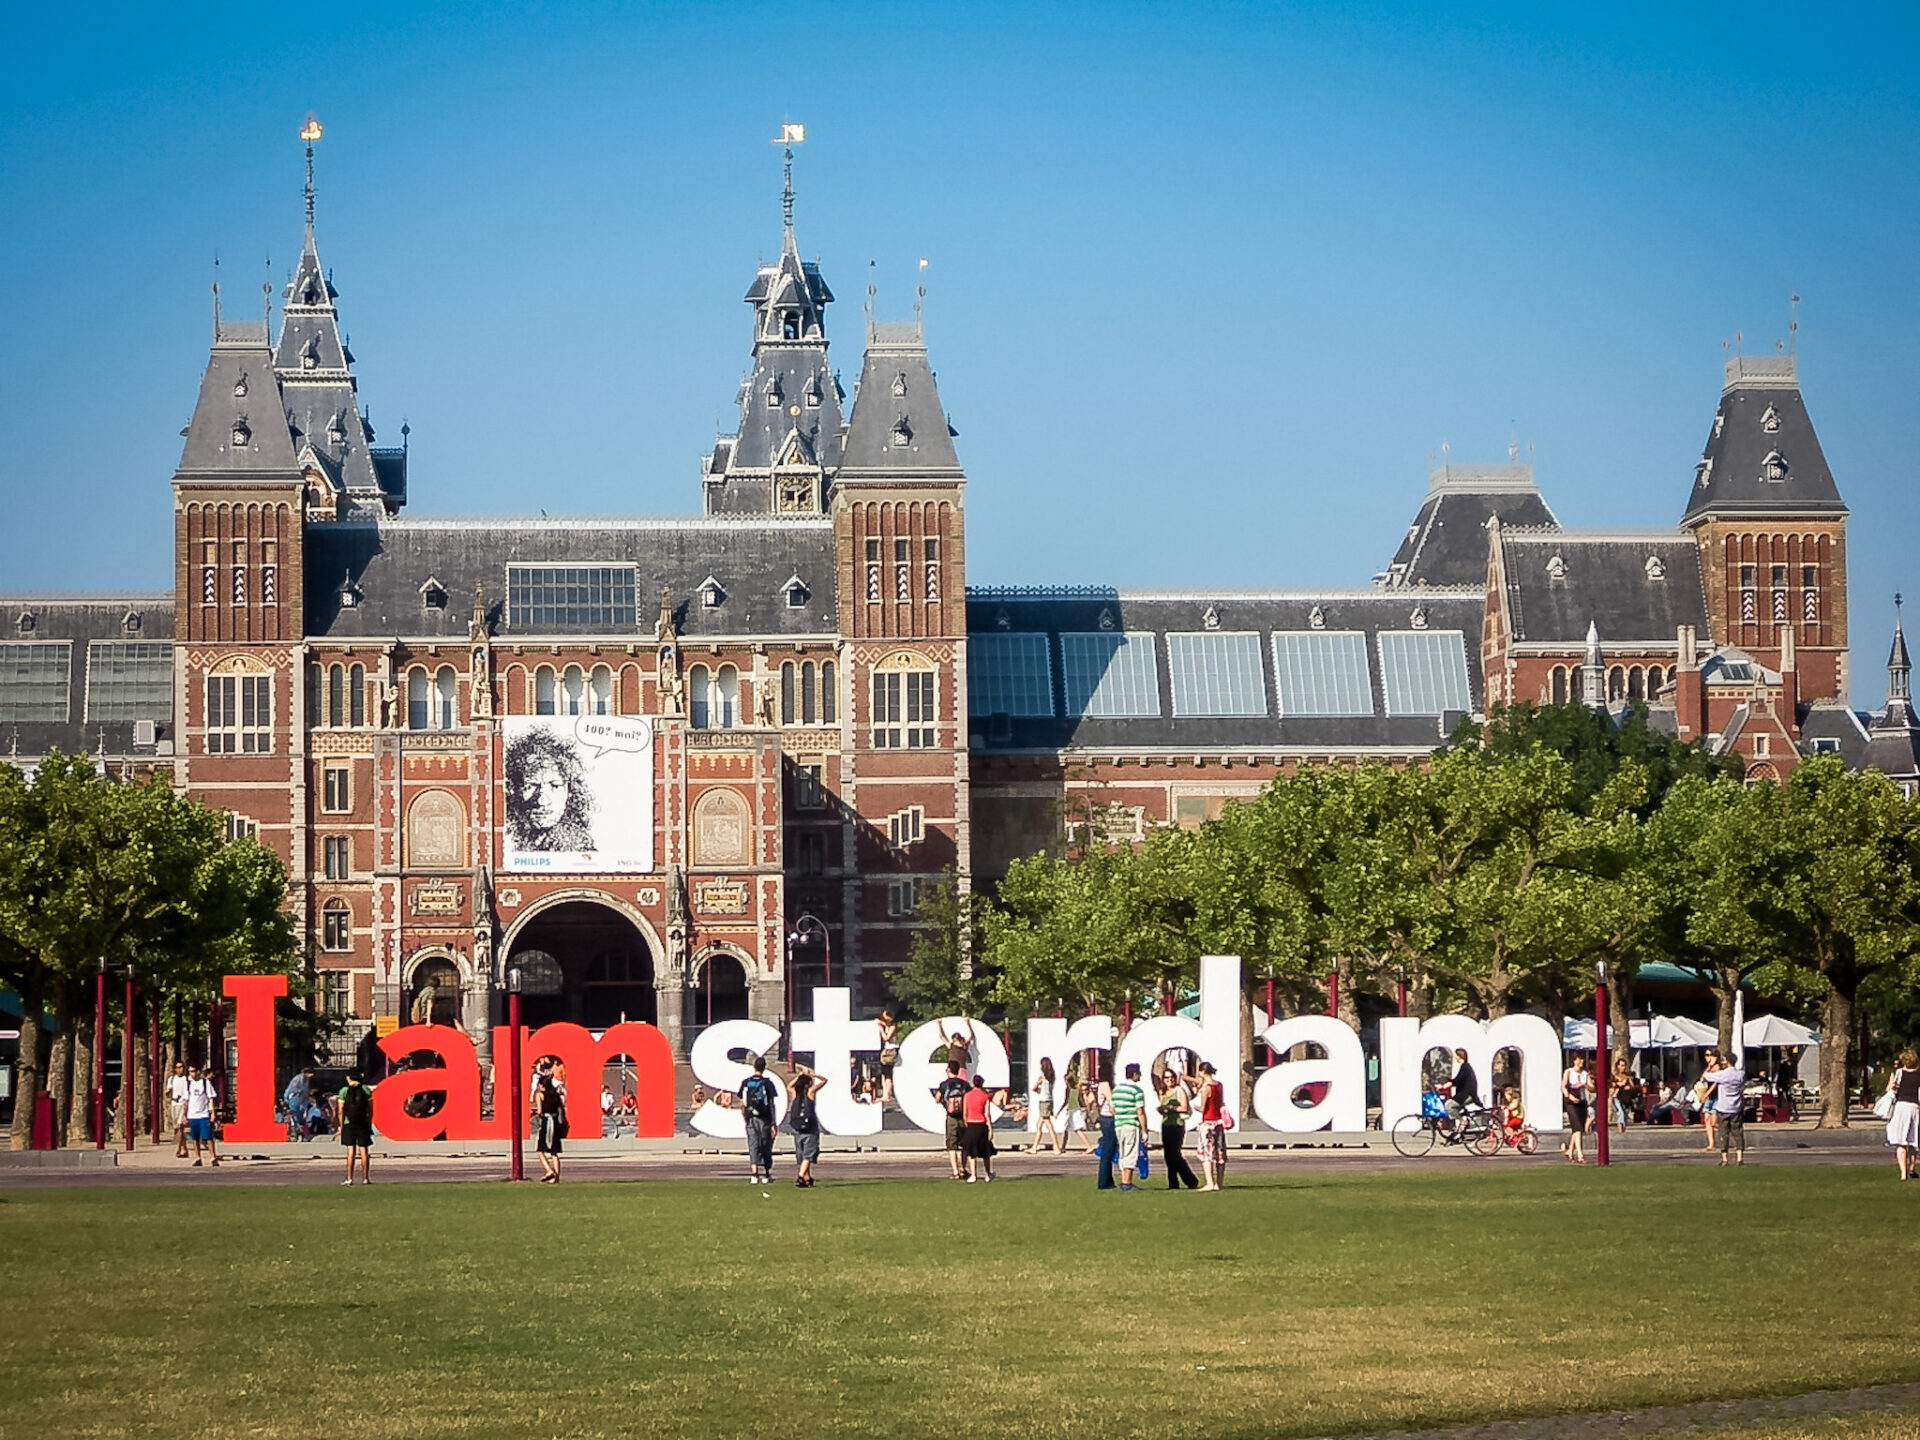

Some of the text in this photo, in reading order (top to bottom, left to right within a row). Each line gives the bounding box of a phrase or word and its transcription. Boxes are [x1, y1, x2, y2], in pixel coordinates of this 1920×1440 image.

[615, 730, 642, 741] moi?
[514, 857, 551, 867] PHILIPS
[223, 975, 288, 1142] I
